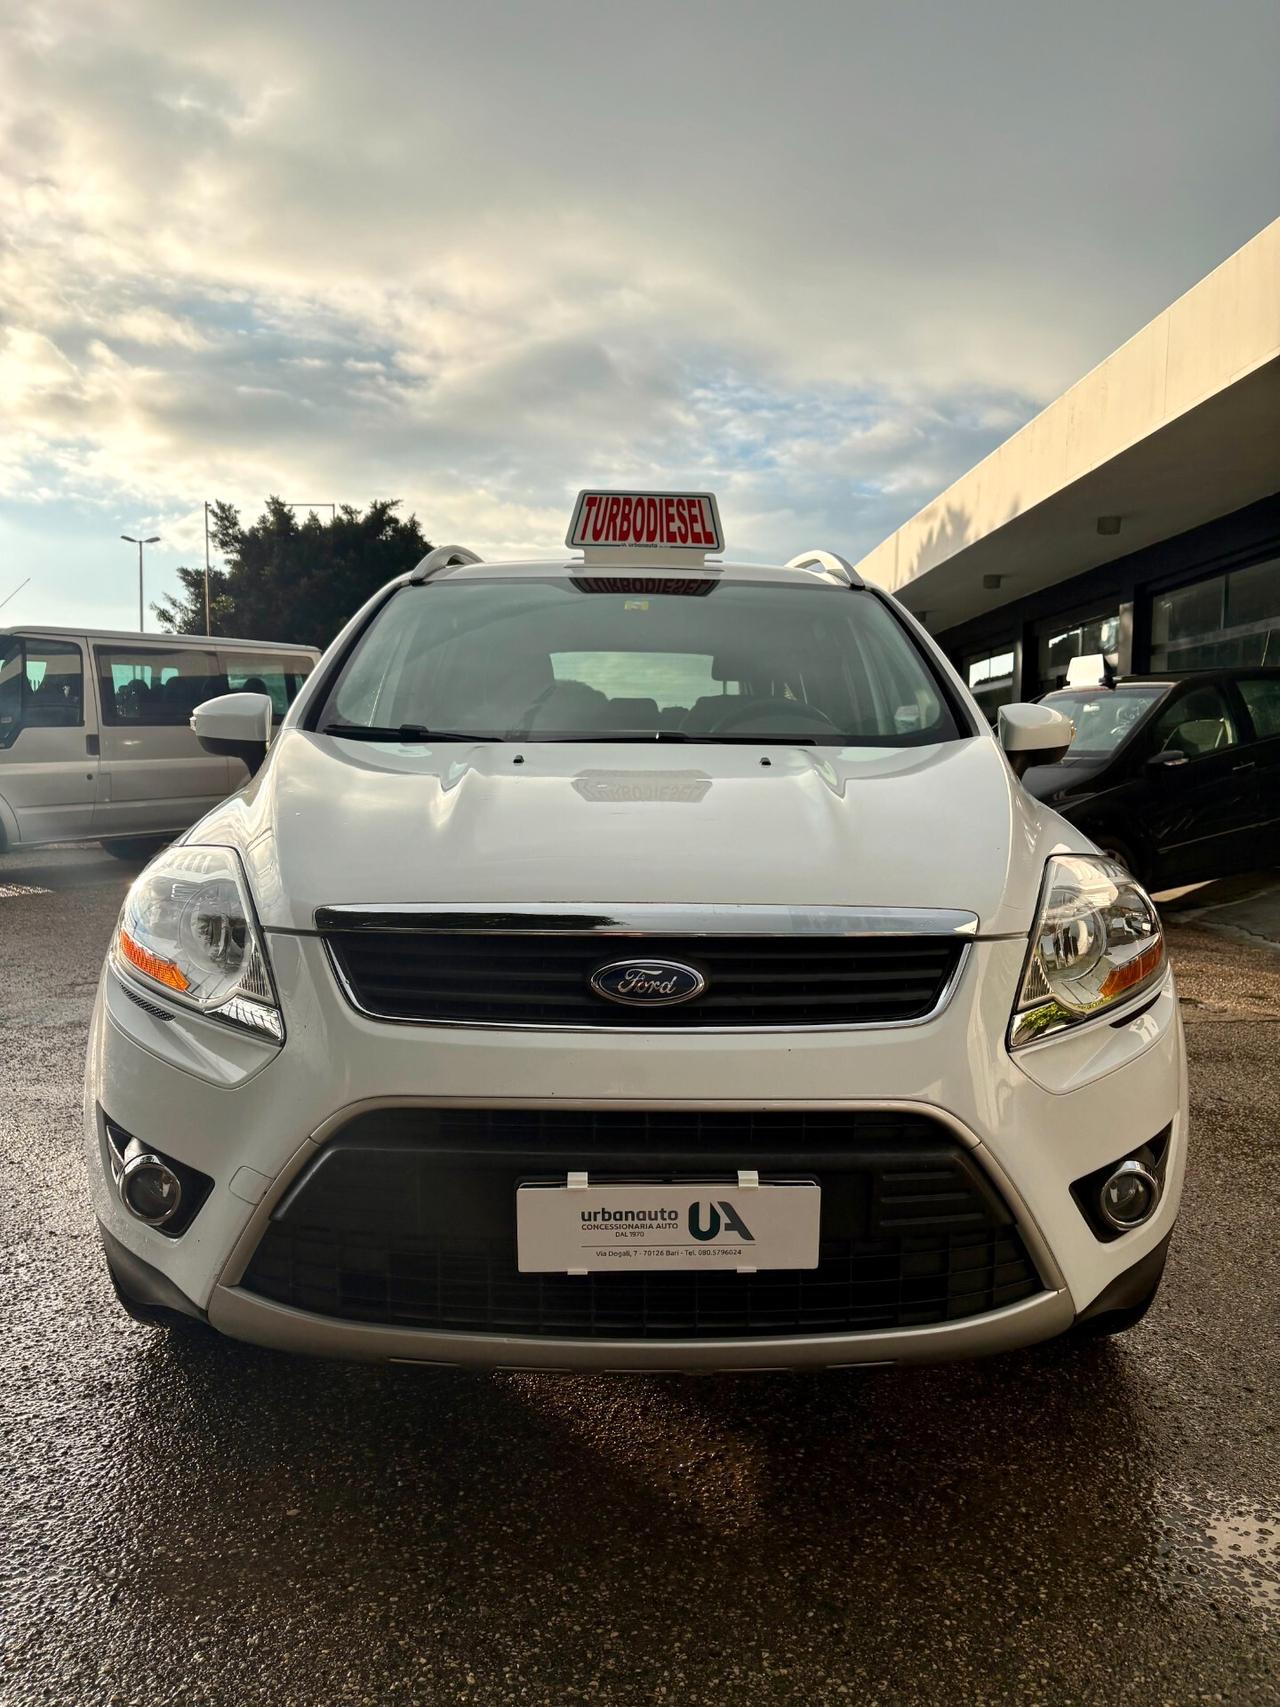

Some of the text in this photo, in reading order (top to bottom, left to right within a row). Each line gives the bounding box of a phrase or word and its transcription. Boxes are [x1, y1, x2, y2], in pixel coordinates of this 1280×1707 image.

[580, 496, 715, 544] TURBODIESEL
[617, 968, 678, 994] Ford
[580, 1207, 679, 1222] urbanauto
[581, 1223, 654, 1231] CONCESSIONARIA
[665, 1249, 680, 1257] Bari
